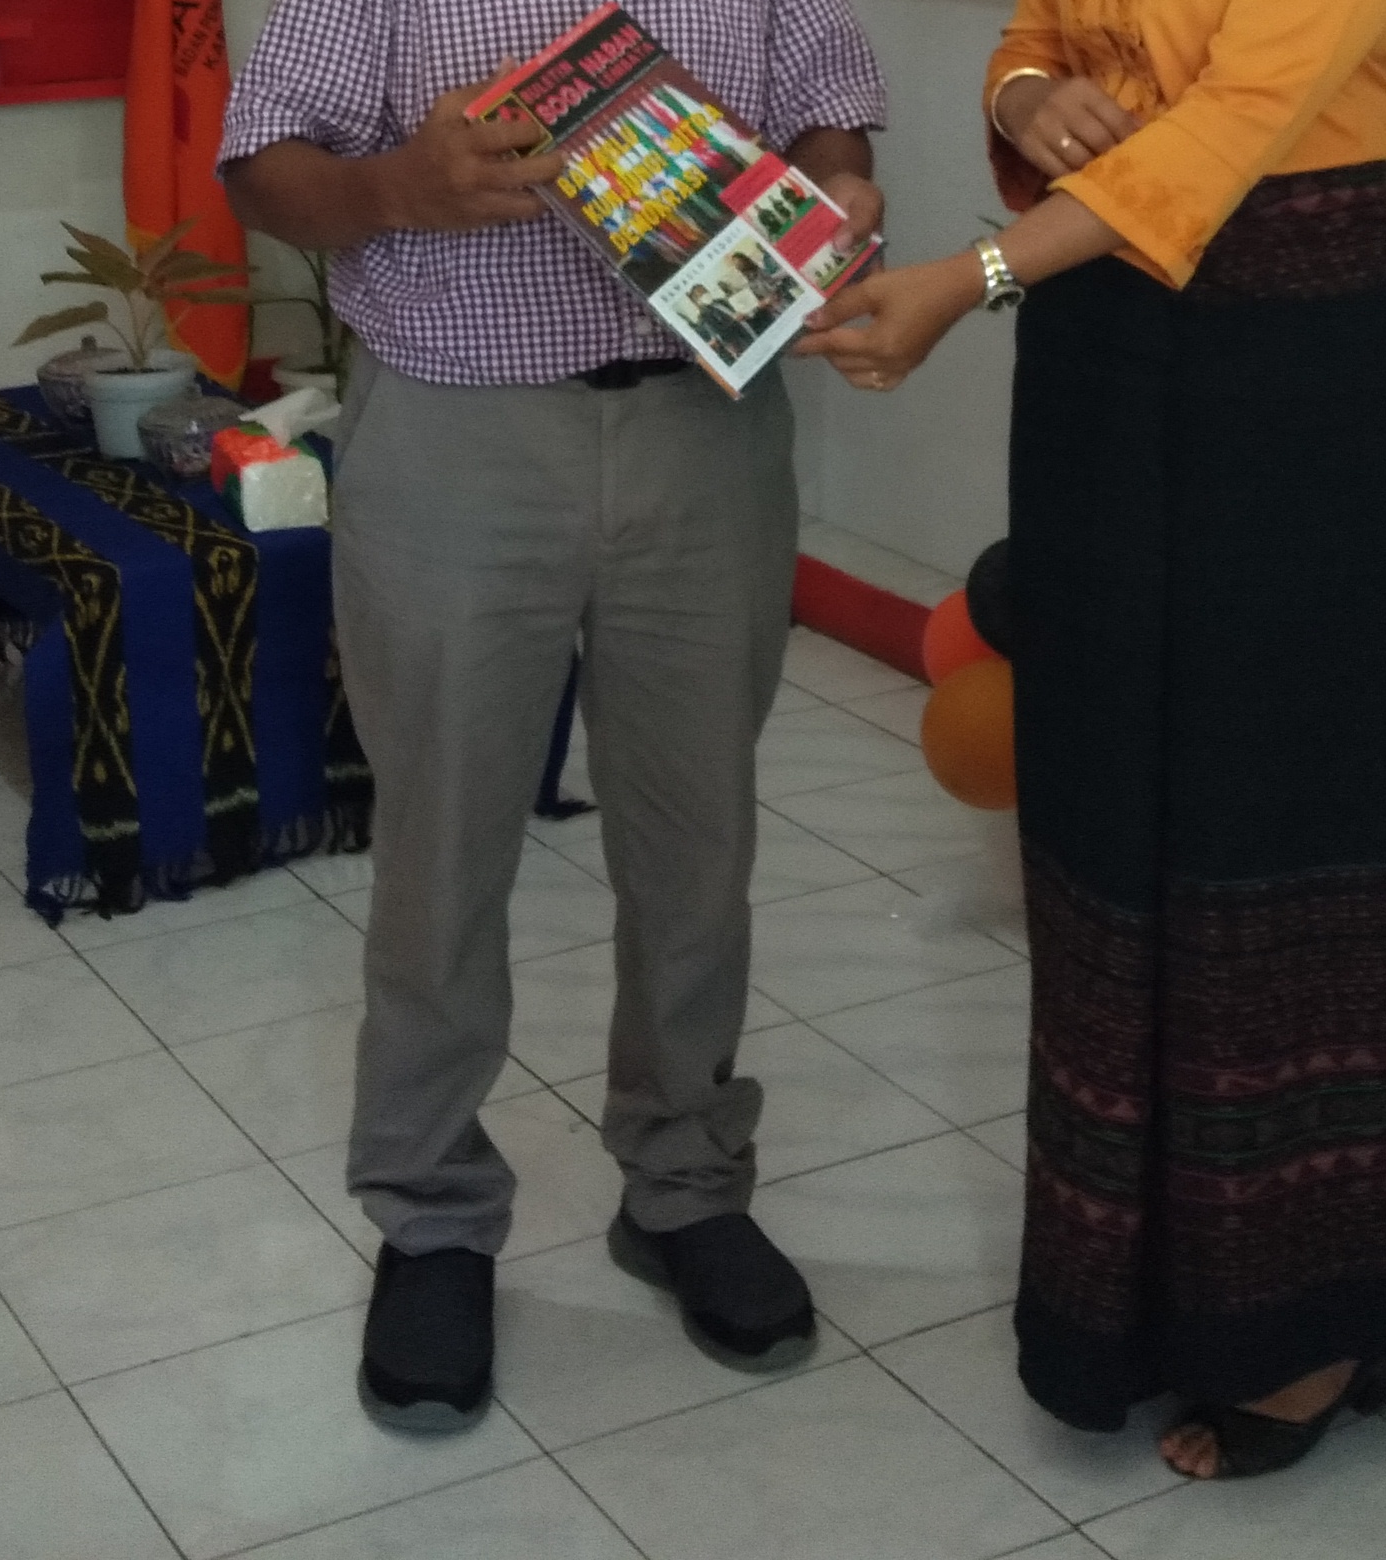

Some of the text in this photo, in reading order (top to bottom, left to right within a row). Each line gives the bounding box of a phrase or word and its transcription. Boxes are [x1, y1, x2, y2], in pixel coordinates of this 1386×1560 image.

[534, 74, 596, 126] SOGA
[664, 101, 723, 155] MITRA
[556, 123, 640, 199] BAWASLU
[609, 164, 709, 254] DEMOKRASI
